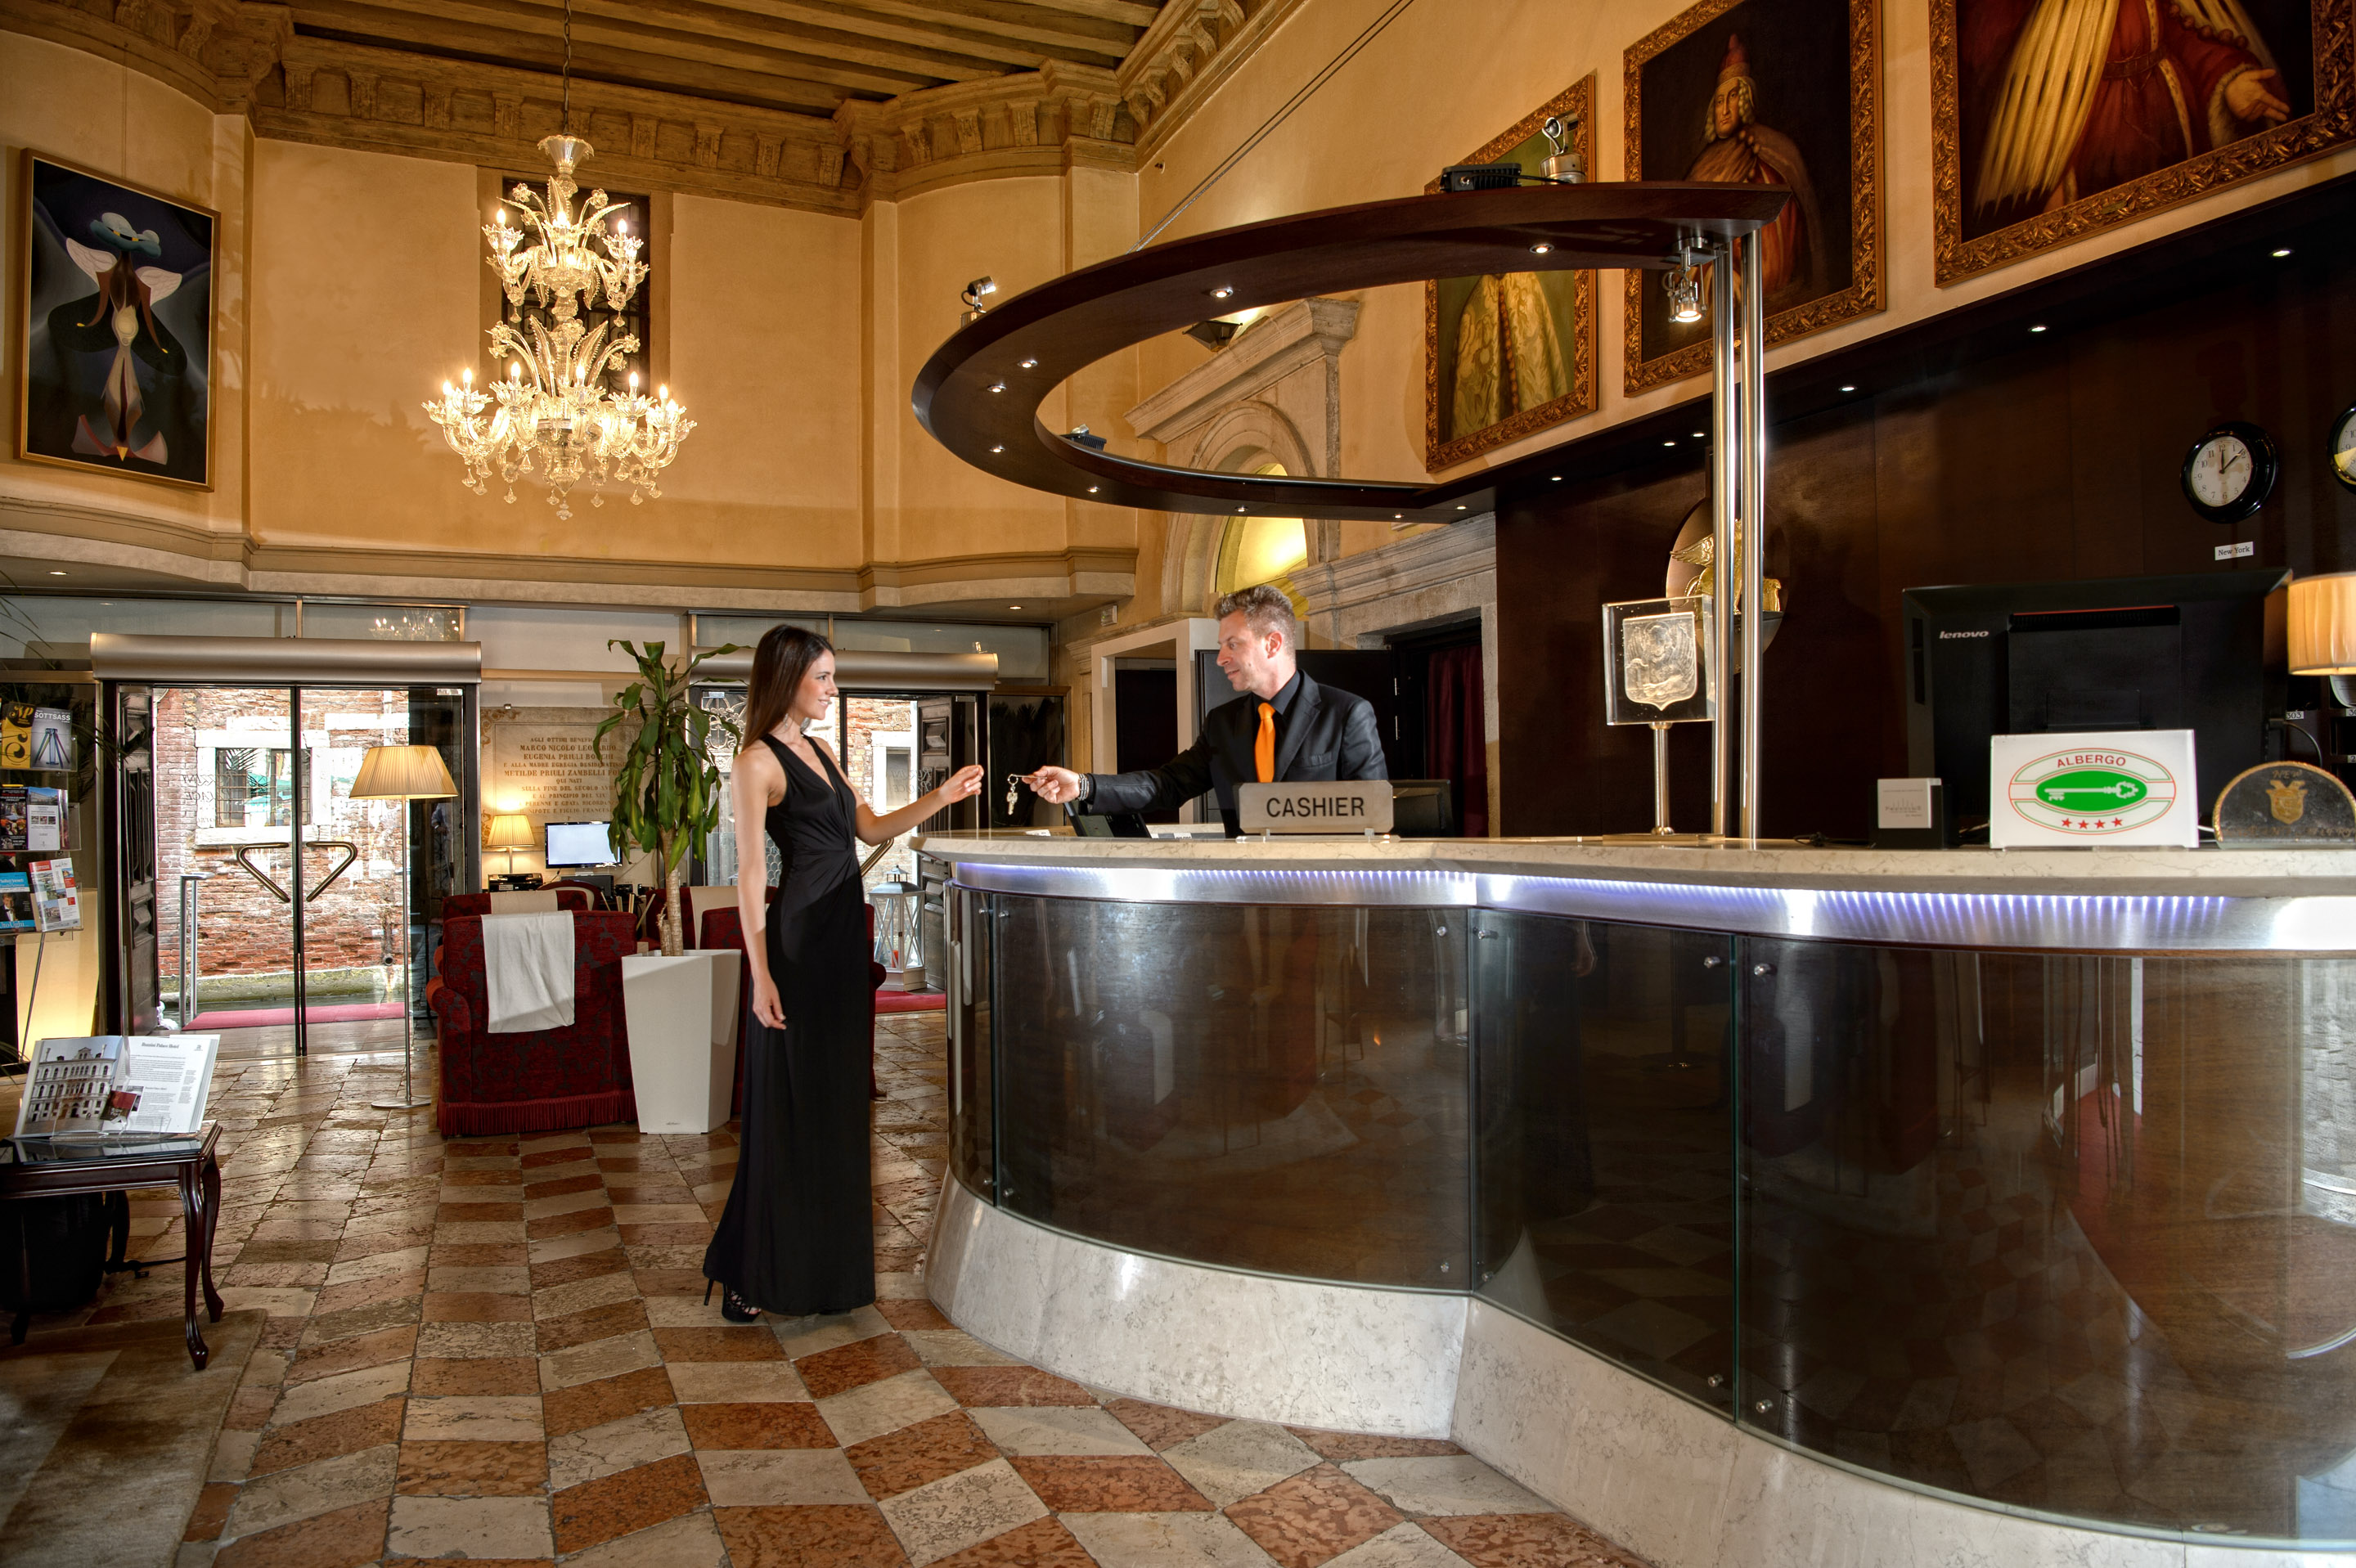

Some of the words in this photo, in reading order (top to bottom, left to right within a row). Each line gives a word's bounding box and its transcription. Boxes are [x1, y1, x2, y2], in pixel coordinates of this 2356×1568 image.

[2209, 450, 2214, 458] 11
[2201, 460, 2208, 468] 10
[2234, 546, 2250, 554] York
[1939, 630, 1990, 639] lenovo
[34, 712, 71, 721] SOTTSASS
[2057, 754, 2126, 768] ALBERGO
[1266, 797, 1365, 817] CASHIER
